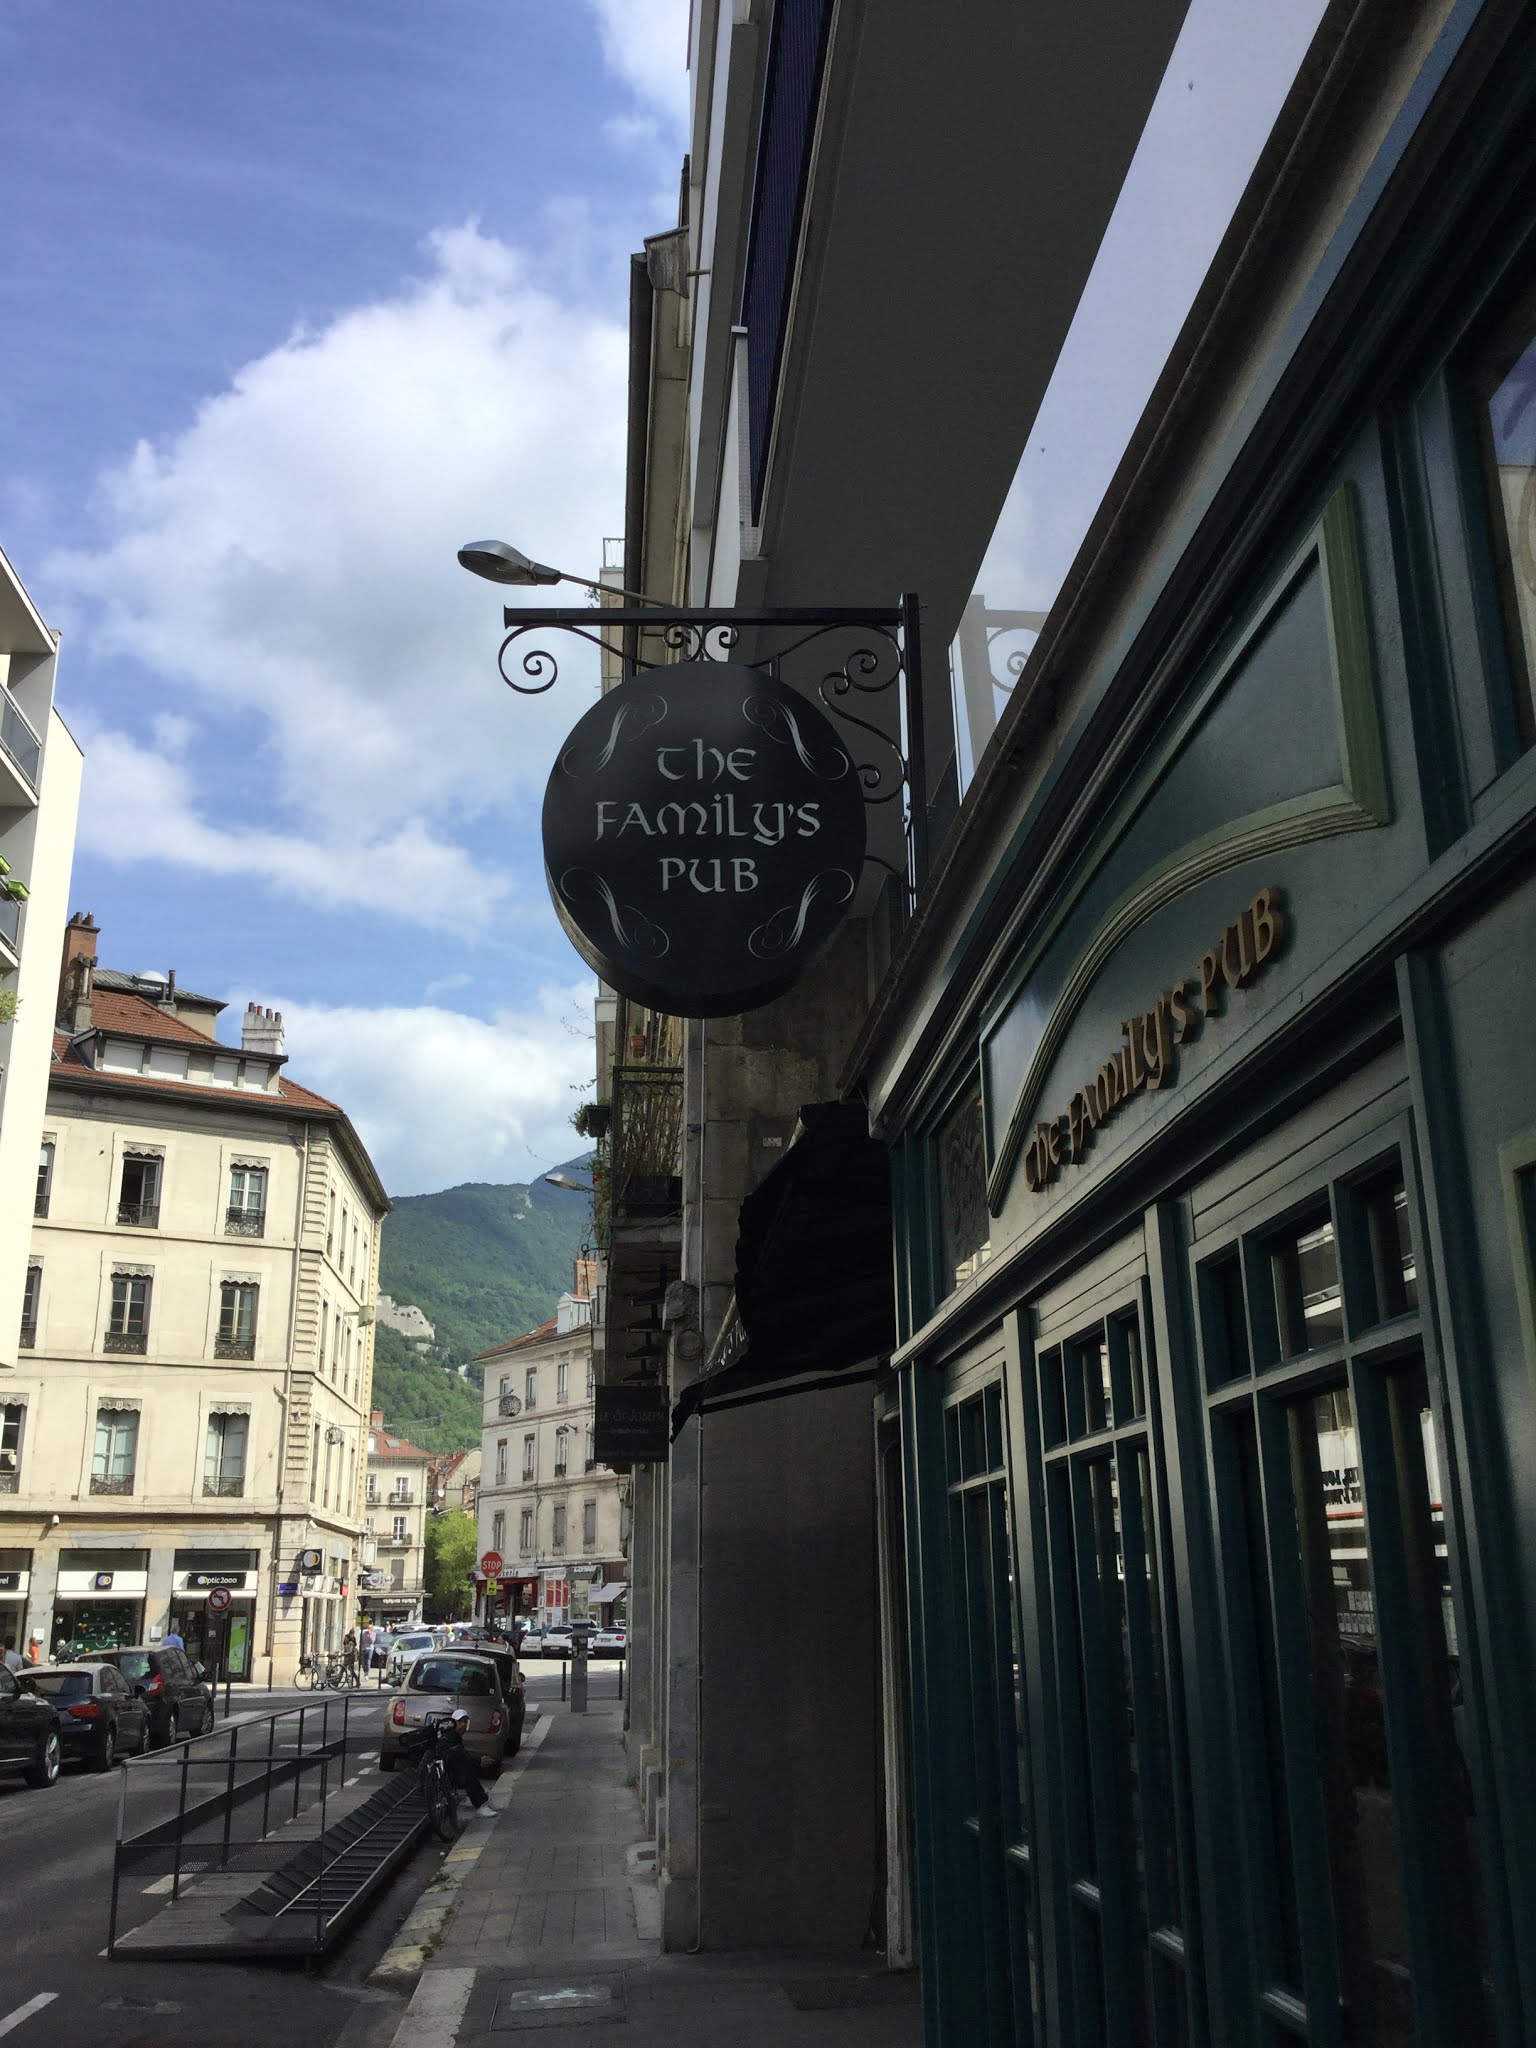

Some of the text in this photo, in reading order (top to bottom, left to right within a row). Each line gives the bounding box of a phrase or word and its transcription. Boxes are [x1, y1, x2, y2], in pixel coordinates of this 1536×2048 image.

[658, 857, 759, 893] PUB
[482, 1560, 501, 1570] STOP
[197, 1575, 220, 1585] Optic
